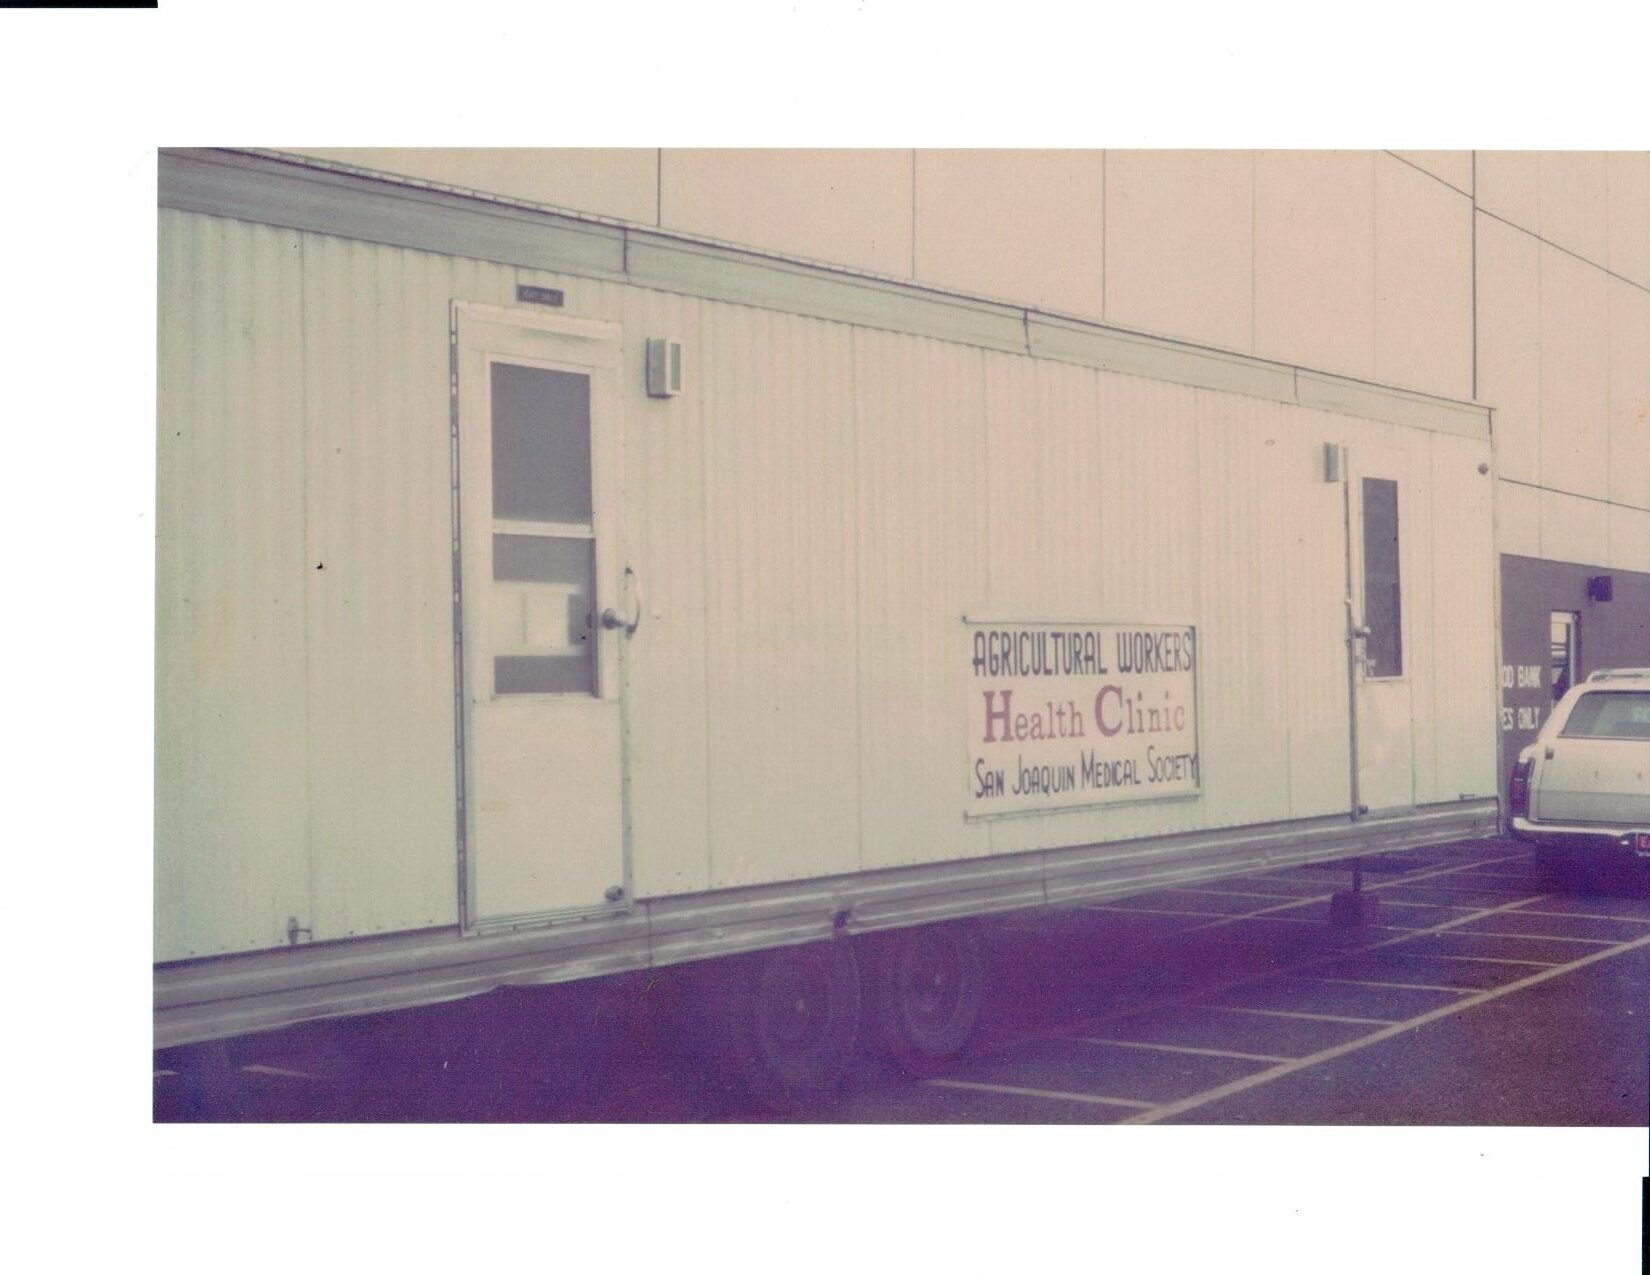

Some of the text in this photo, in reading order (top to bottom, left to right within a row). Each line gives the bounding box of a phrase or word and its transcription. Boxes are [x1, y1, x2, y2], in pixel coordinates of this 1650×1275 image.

[972, 630, 1192, 676] AGRICULTURAL WORKERS
[1518, 665, 1541, 687] BANK
[982, 684, 1185, 743] Health Clinic
[1518, 707, 1540, 730] ONLY
[975, 745, 1200, 799] SAN JOAQUIN MEDICAL SOCIETY
